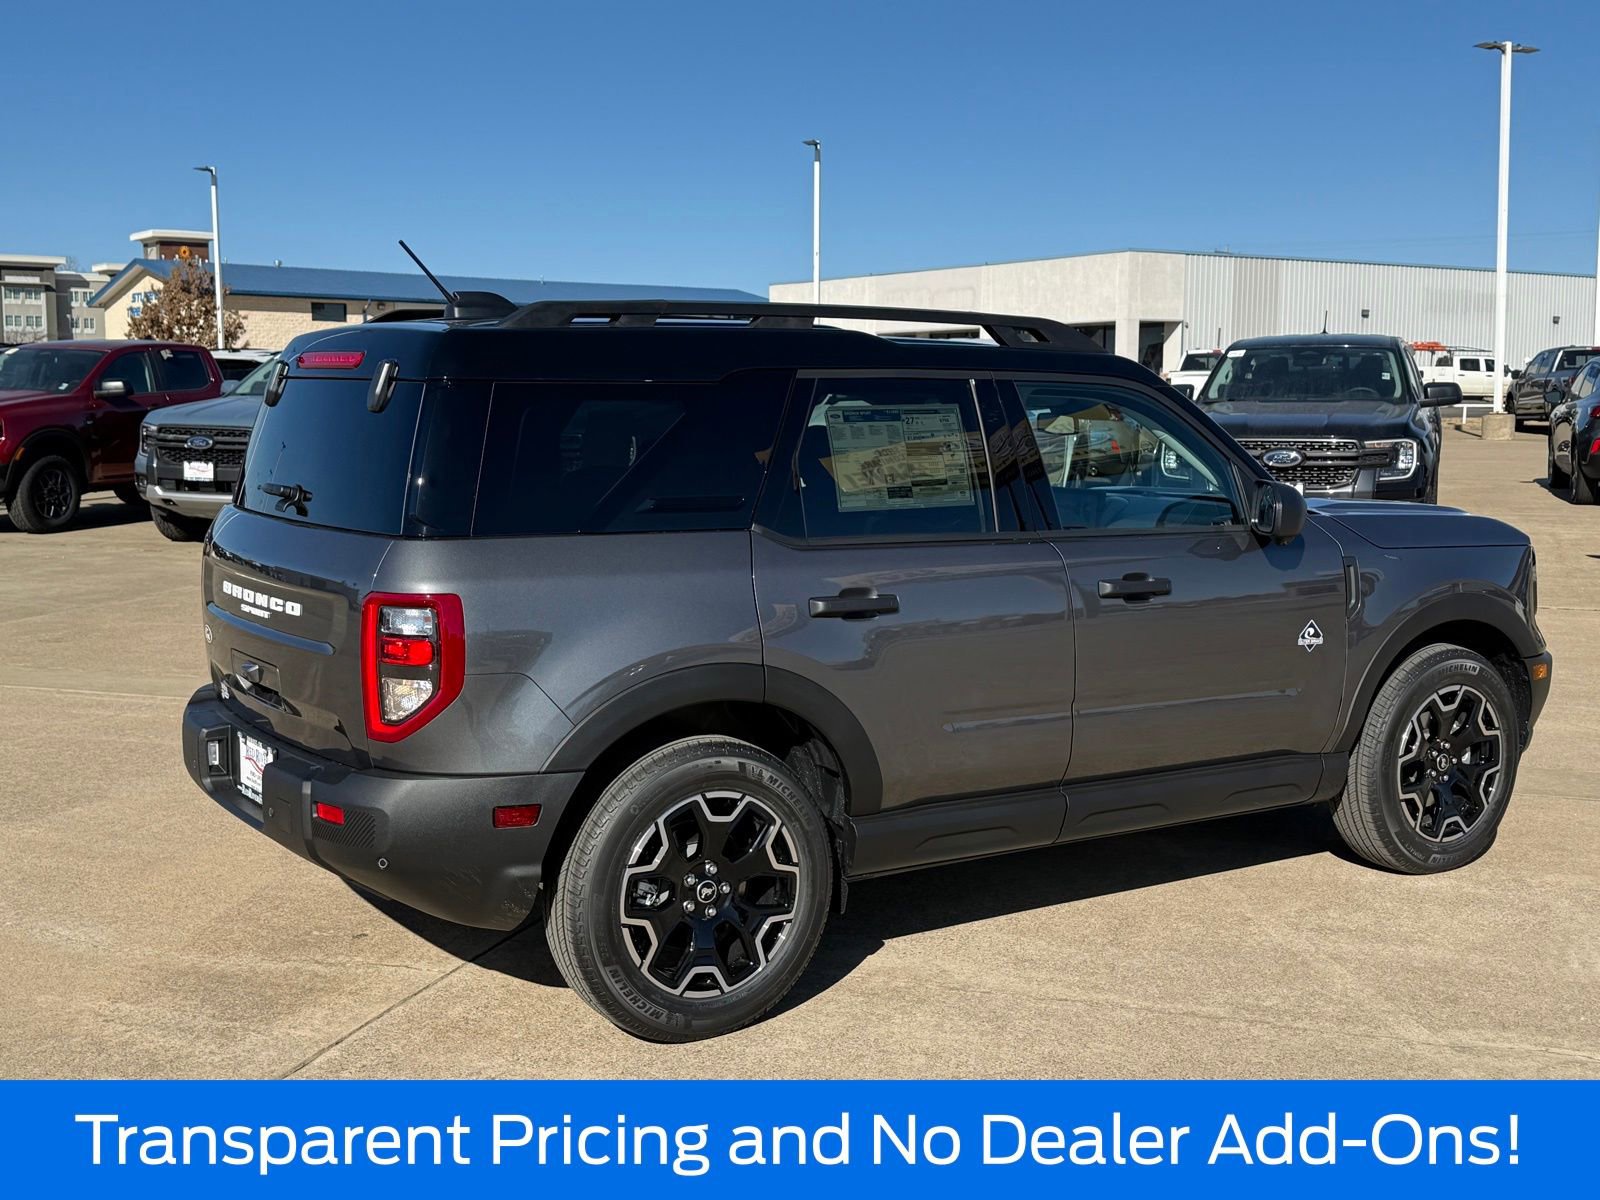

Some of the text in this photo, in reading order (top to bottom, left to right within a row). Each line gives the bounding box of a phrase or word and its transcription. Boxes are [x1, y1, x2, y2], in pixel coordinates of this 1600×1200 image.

[222, 580, 302, 617] BRONCO
[240, 603, 271, 619] SPORT
[1440, 663, 1479, 674] MICHELIN
[608, 968, 665, 1020] MICHELIN
